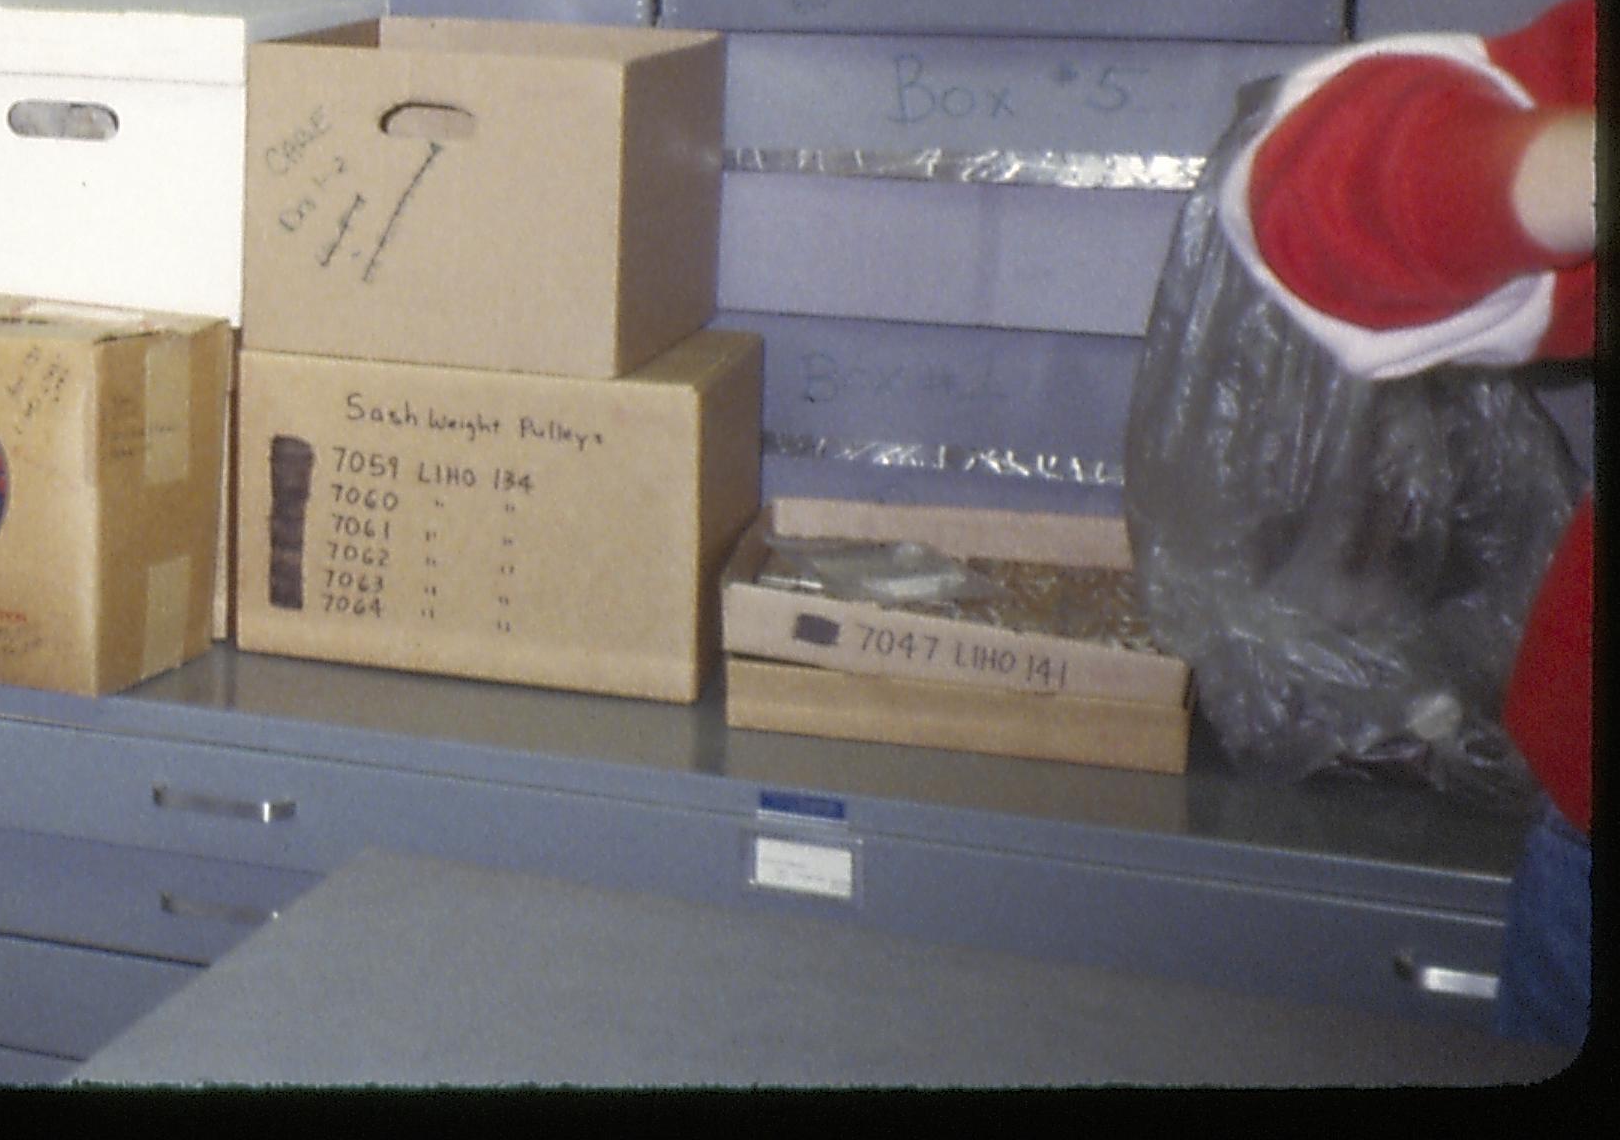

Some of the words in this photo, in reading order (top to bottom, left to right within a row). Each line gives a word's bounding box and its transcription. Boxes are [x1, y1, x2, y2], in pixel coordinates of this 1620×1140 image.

[886, 51, 1015, 124] Box
[345, 390, 419, 428] Sash
[427, 405, 501, 444] Weight
[518, 414, 605, 452] Pulleys
[331, 446, 400, 480] 7059
[417, 460, 477, 489] LIHO
[492, 468, 536, 496] 134
[331, 484, 399, 513] 7060
[330, 513, 391, 542] 7061
[326, 541, 390, 568] 7062
[324, 568, 385, 595] 7063
[322, 594, 383, 619] 7064
[860, 623, 939, 661] 7047
[954, 641, 1017, 675] LIHO
[1026, 653, 1069, 690] 141
